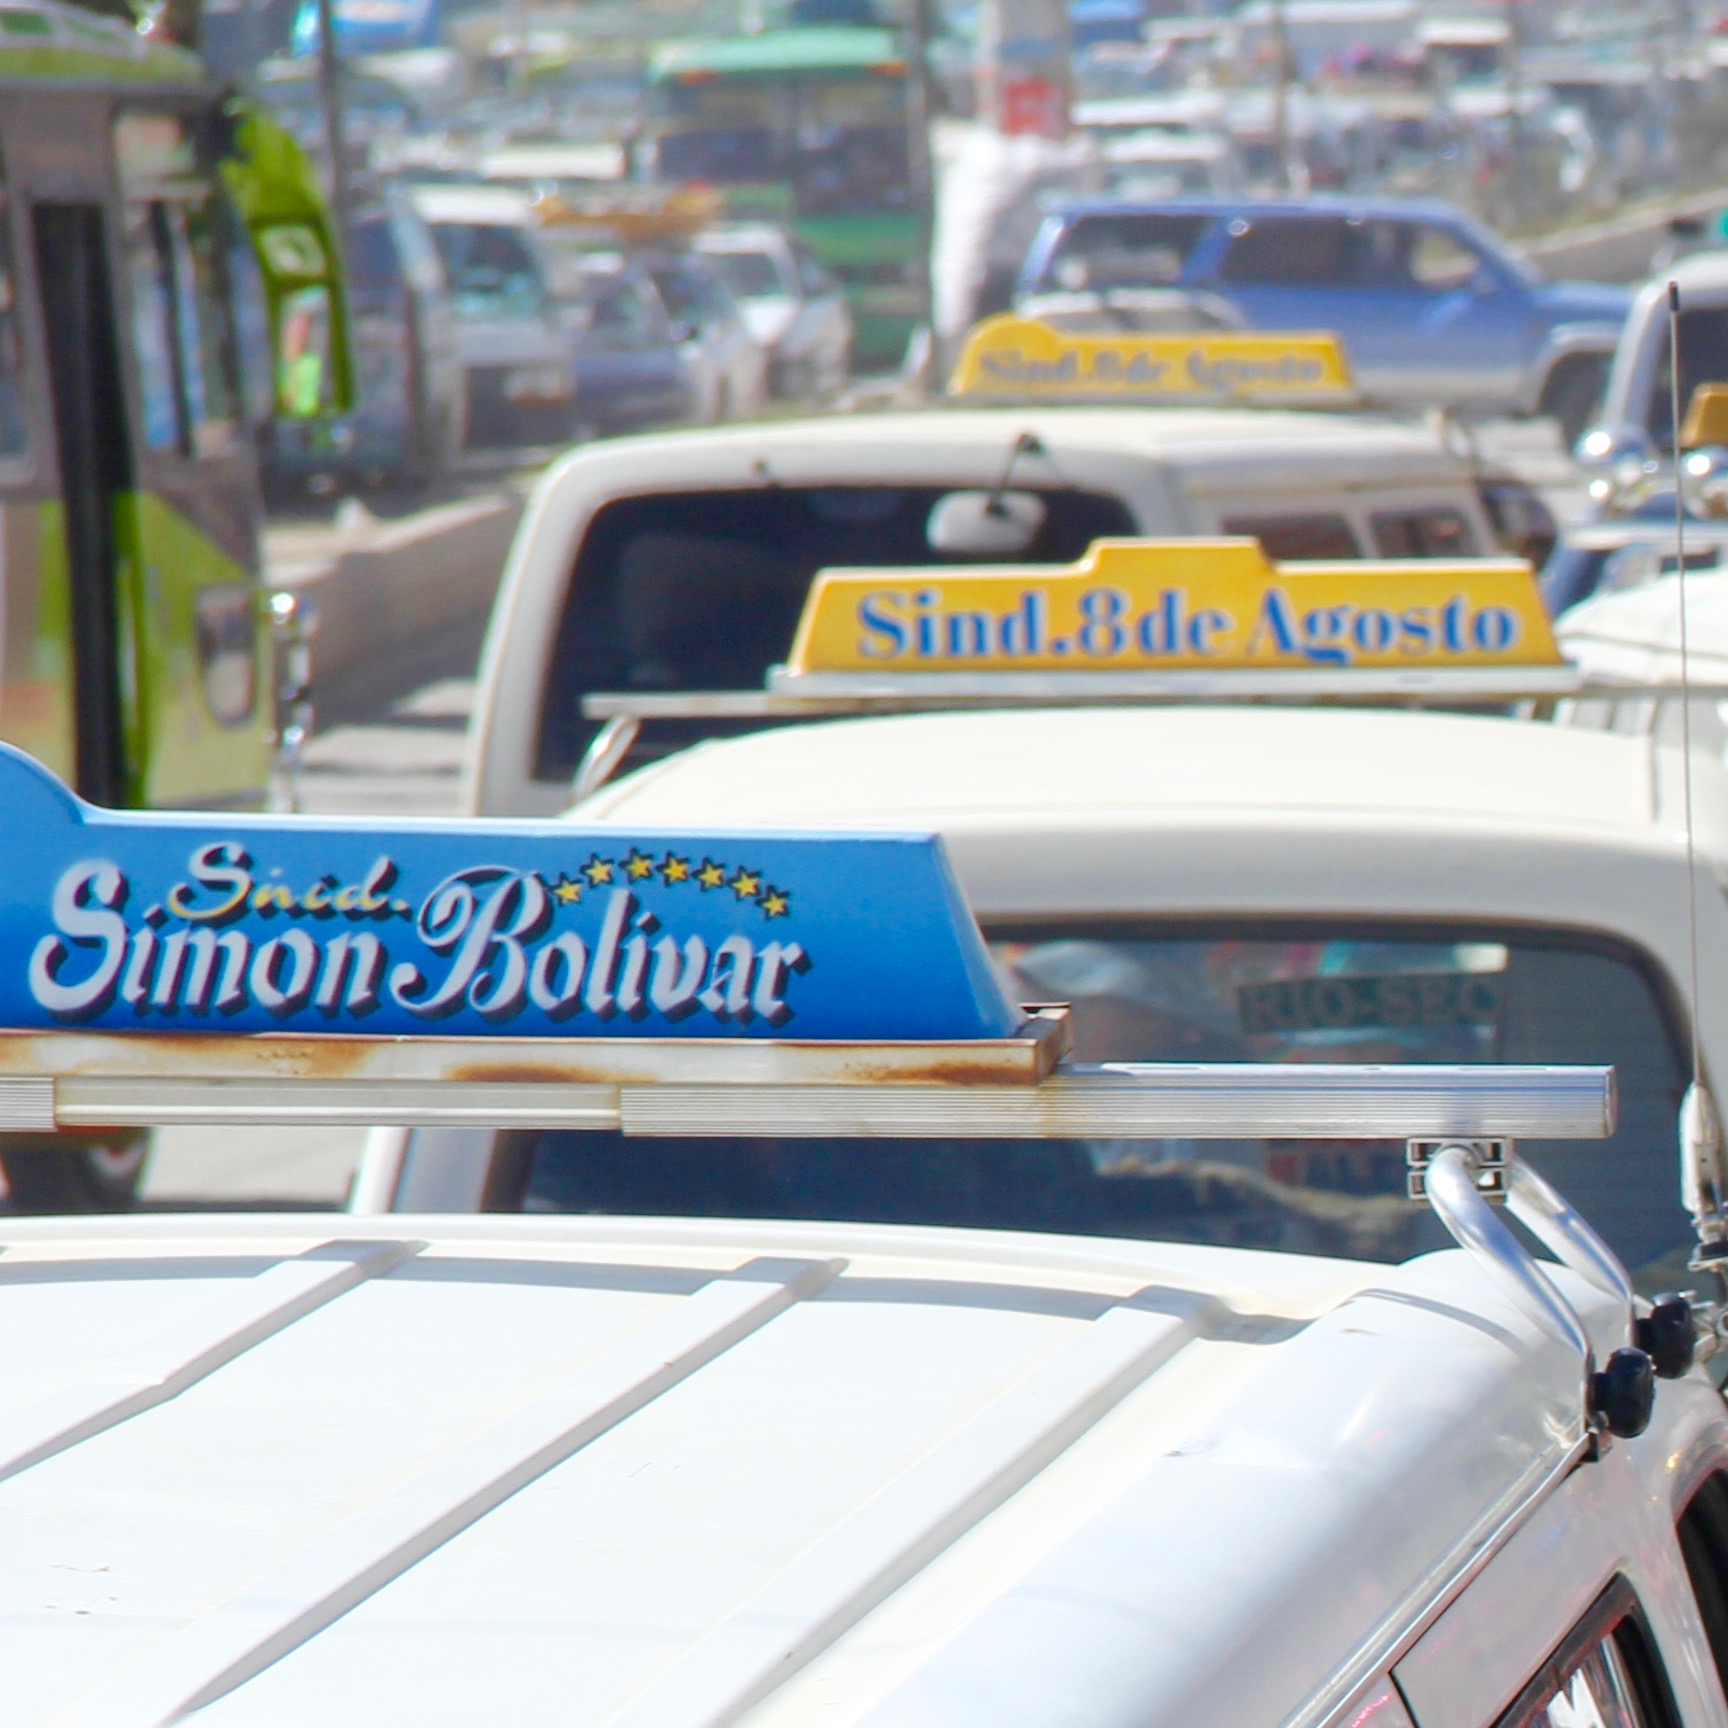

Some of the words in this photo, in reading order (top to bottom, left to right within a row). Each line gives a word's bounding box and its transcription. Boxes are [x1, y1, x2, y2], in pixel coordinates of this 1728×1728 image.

[1246, 586, 1521, 666] Agosto
[28, 857, 384, 1016] Simon
[387, 863, 814, 1024] Bolivar
